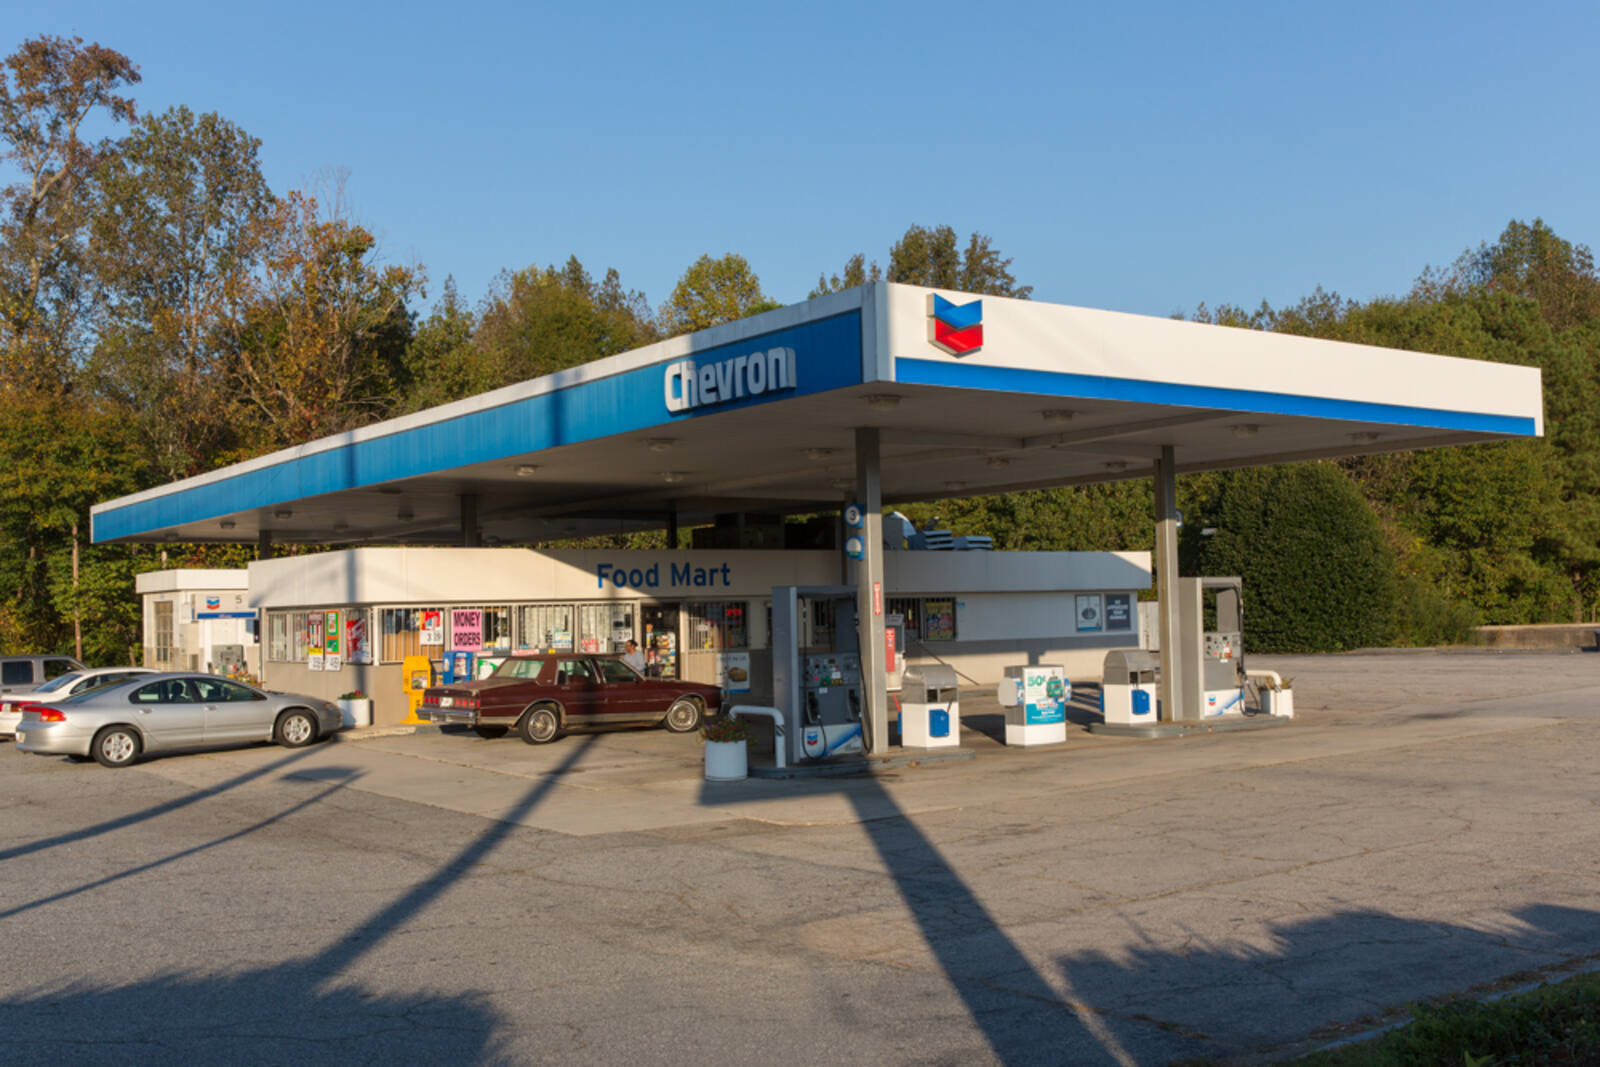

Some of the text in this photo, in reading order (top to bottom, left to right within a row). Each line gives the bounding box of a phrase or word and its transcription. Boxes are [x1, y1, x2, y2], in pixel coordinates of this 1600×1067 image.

[664, 347, 796, 412] Chevron
[849, 510, 857, 521] 3
[597, 562, 731, 588] Food Mart
[454, 611, 481, 627] MONEY
[454, 632, 481, 647] ORDERS
